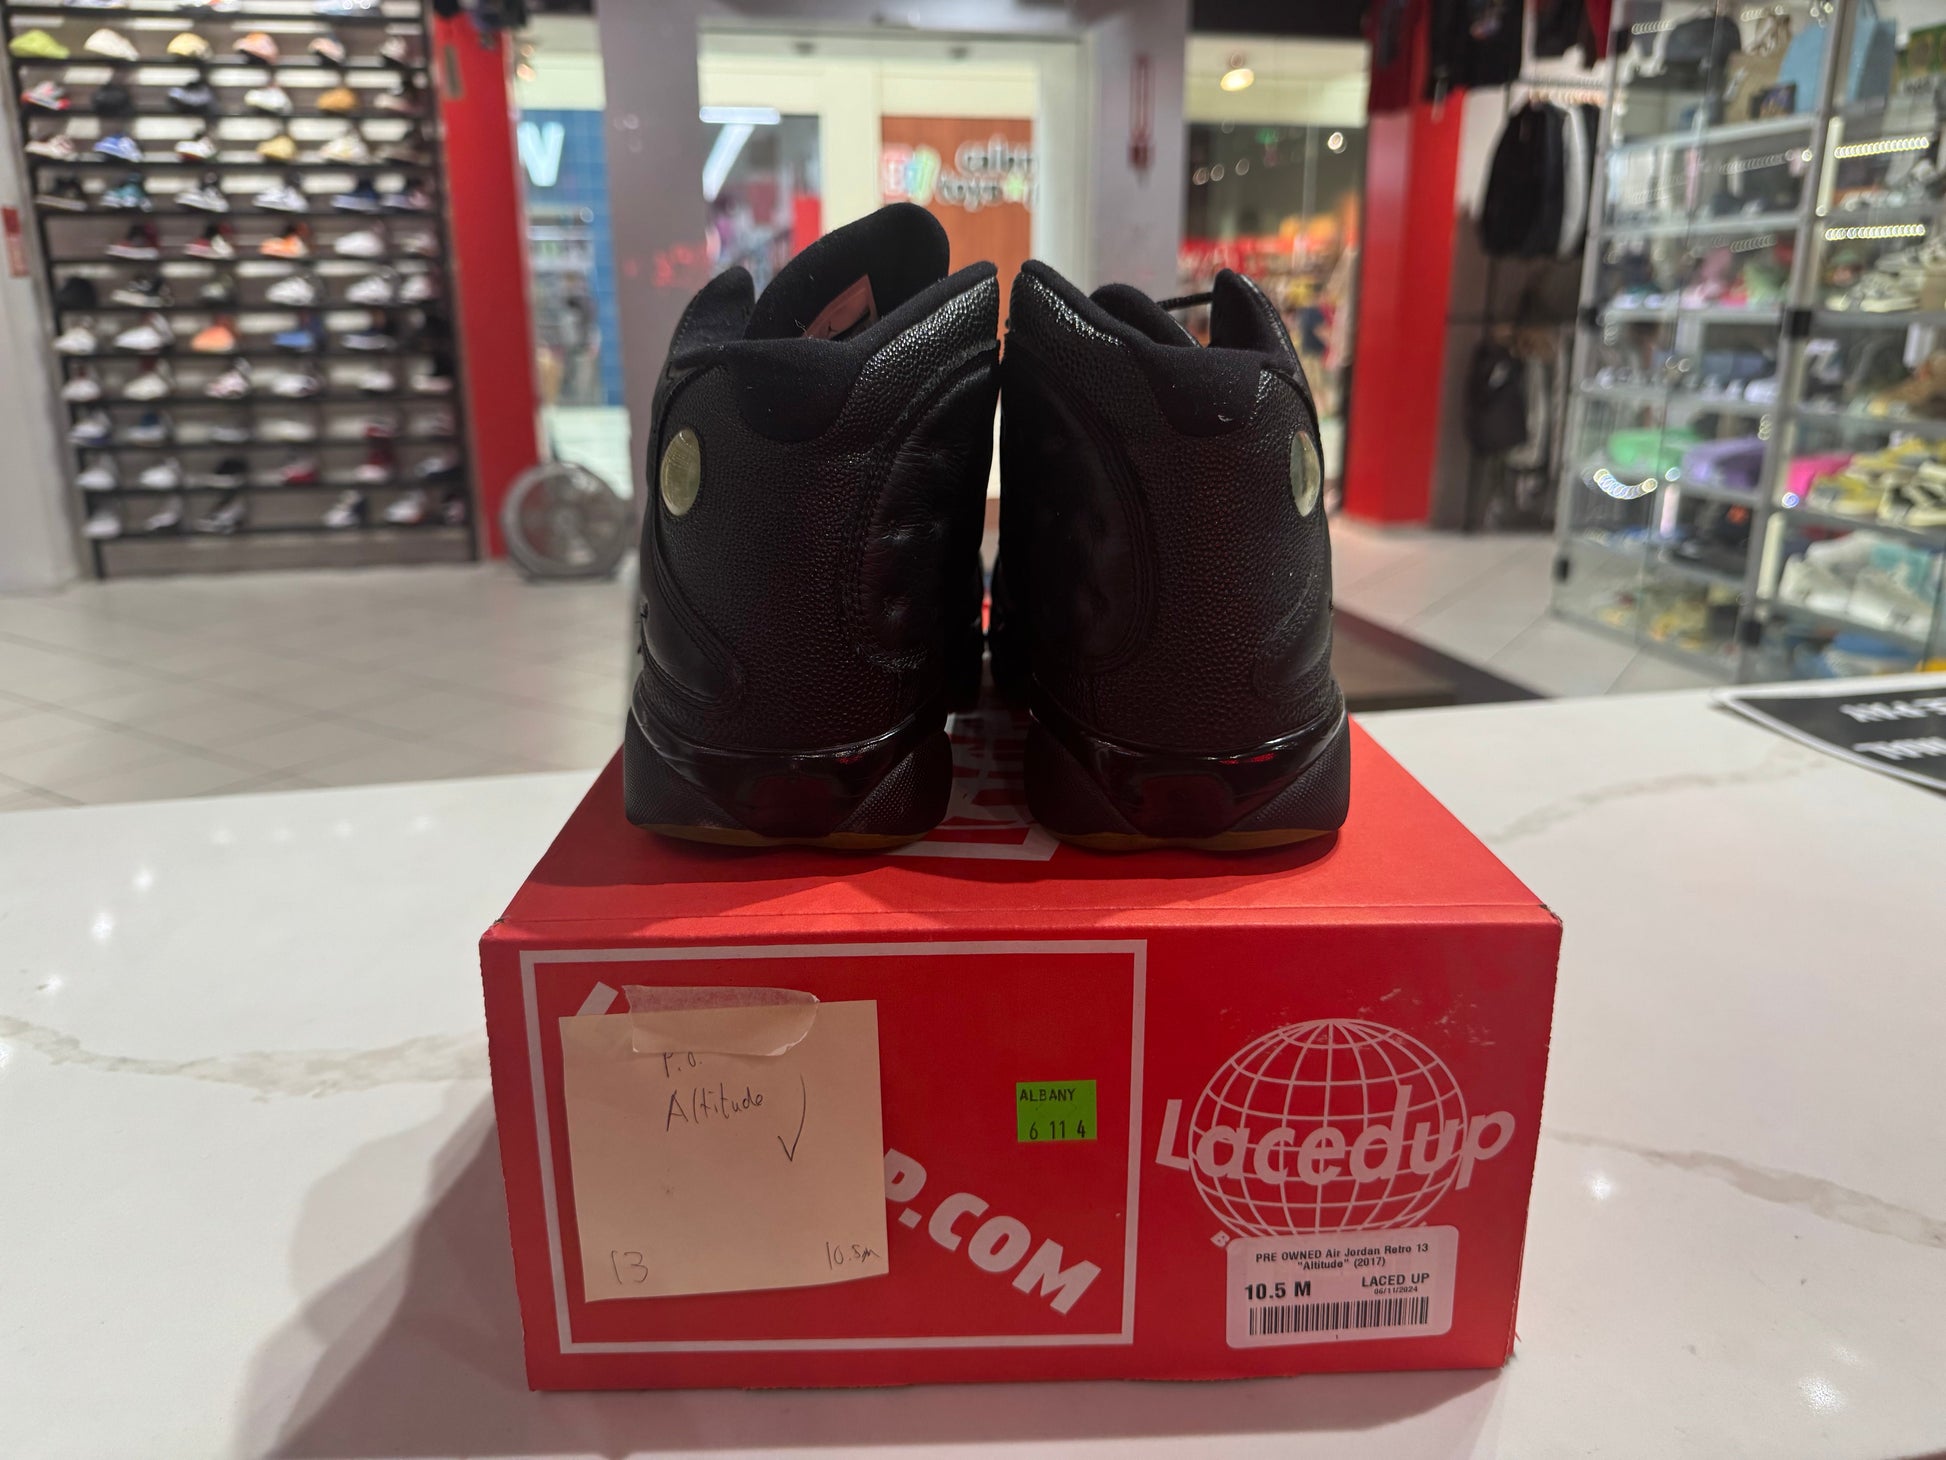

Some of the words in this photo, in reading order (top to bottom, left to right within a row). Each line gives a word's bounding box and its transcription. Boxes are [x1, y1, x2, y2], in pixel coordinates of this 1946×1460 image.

[1019, 1088, 1076, 1102] ALBANY
[666, 1082, 764, 1132] Altitude
[1029, 1121, 1039, 1140] 6
[1076, 1119, 1087, 1139] 4
[1155, 1084, 1515, 1190] Lacedup
[1255, 1252, 1278, 1263] PRE
[1281, 1249, 1322, 1261] OWNED
[1325, 1248, 1341, 1258] Air
[1344, 1246, 1381, 1258] Jordan
[1384, 1244, 1412, 1255] Retro
[1416, 1242, 1429, 1253] 13
[611, 1249, 649, 1285] 13
[1297, 1259, 1349, 1271] "Altitude"
[1353, 1256, 1386, 1270] (2017)
[1244, 1281, 1287, 1301] 10.5
[1294, 1280, 1312, 1298] M
[1361, 1273, 1406, 1288] LACED
[1411, 1272, 1430, 1285] UP
[1373, 1285, 1418, 1295] 06/11/2024
